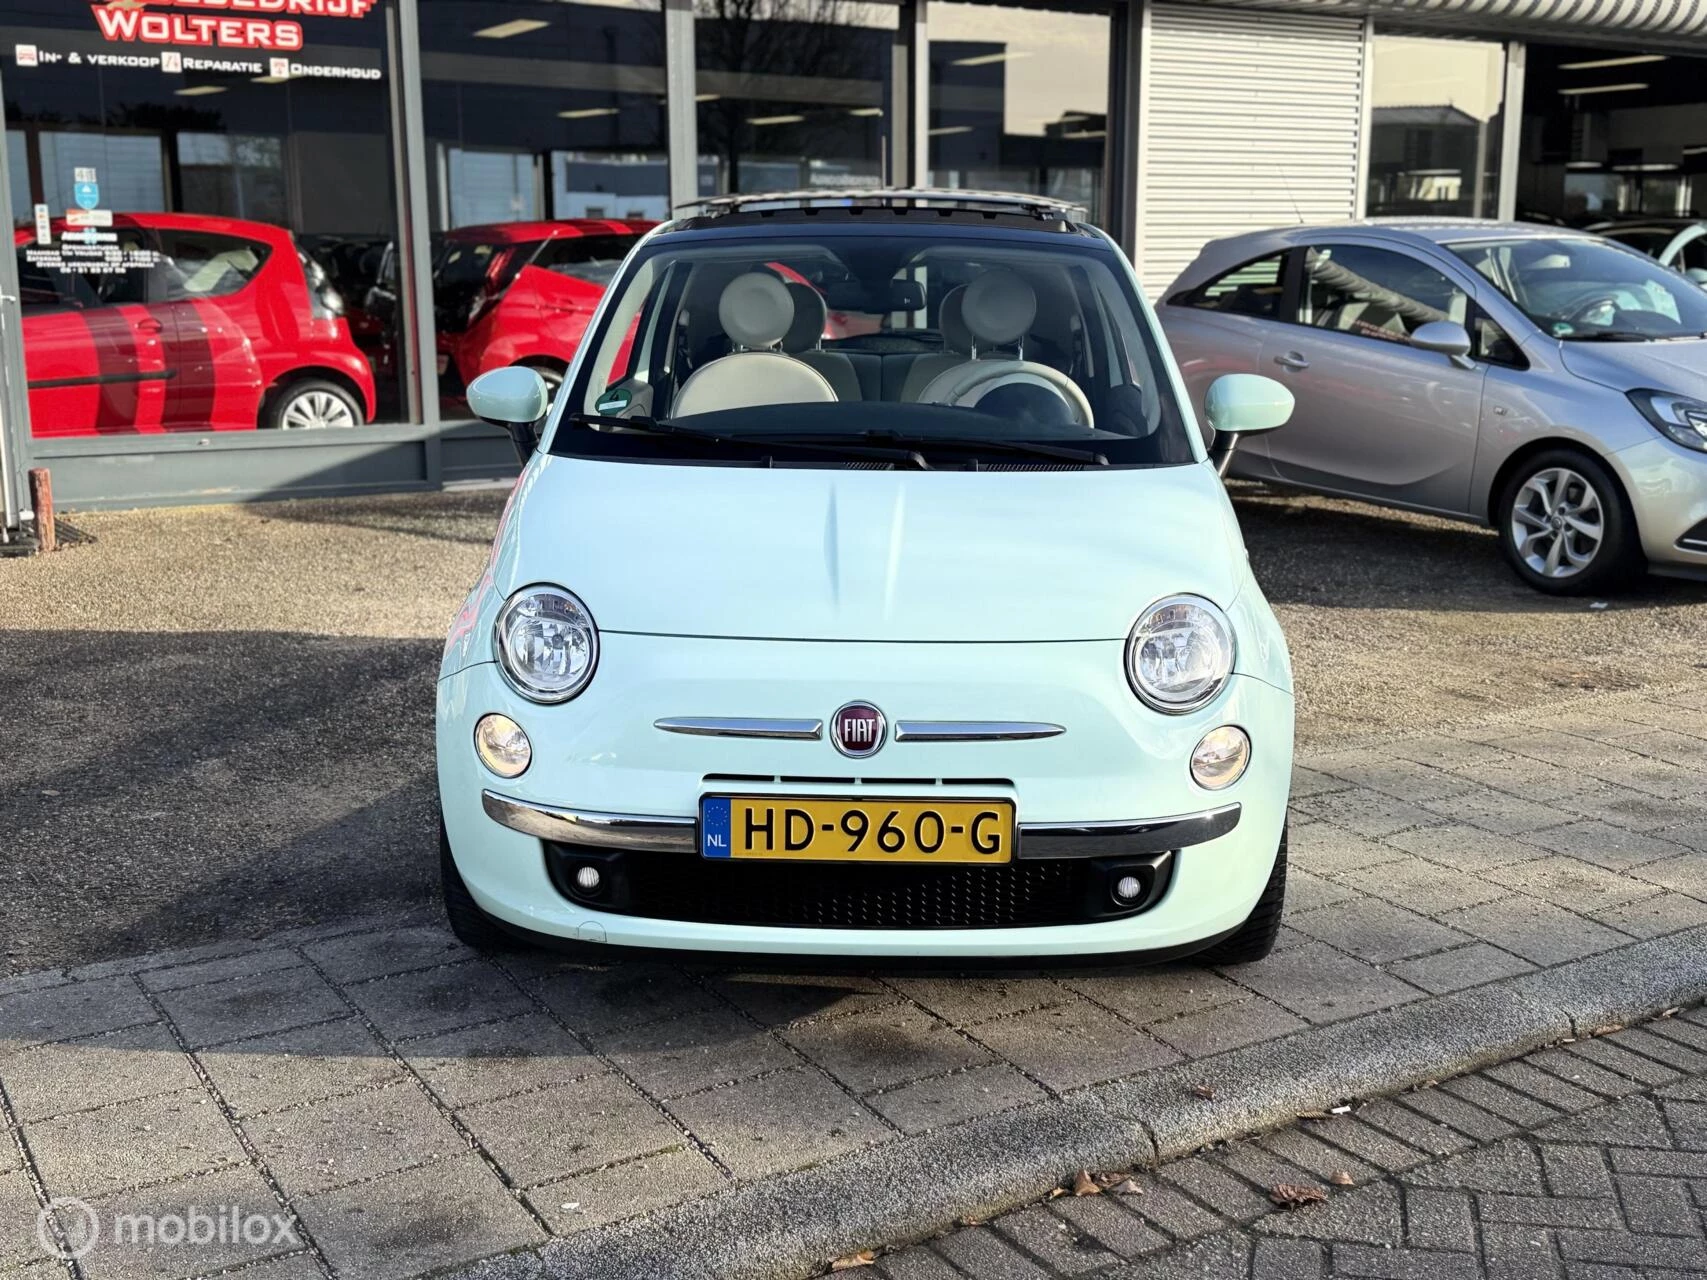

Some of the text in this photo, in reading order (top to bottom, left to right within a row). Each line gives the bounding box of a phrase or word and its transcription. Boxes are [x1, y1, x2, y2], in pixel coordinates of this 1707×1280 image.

[95, 7, 301, 47] WOLTERS
[68, 52, 82, 64] &
[87, 54, 160, 67] VERKOOP
[183, 57, 263, 73] REPARATIE
[290, 63, 381, 80] ONDERHOUD
[844, 718, 876, 742] FIAT
[744, 807, 1001, 855] HD-960-G
[707, 833, 727, 847] NL
